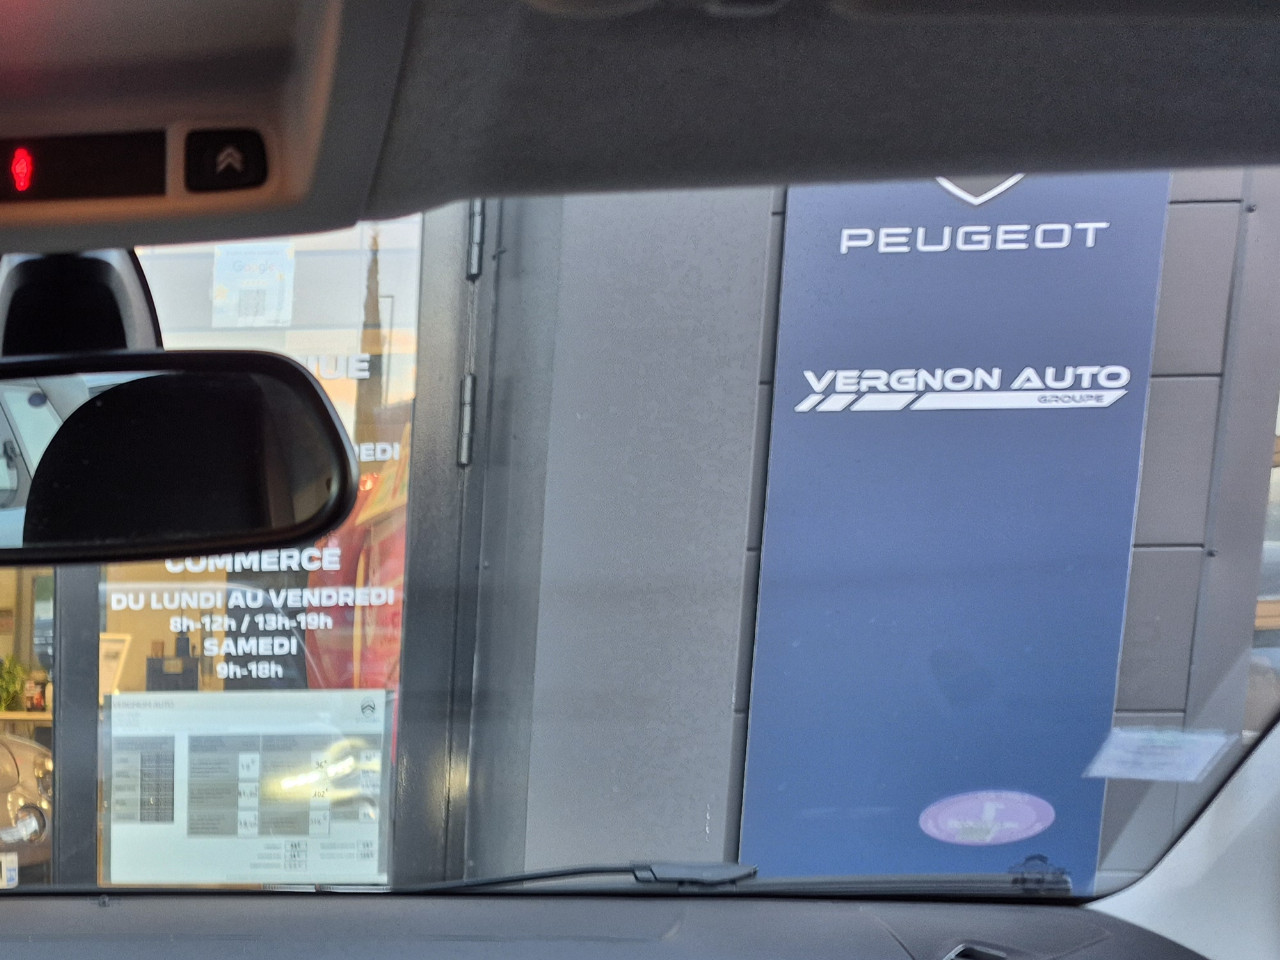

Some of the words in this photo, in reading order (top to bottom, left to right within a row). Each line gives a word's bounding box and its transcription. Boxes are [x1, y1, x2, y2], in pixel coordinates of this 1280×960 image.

[839, 221, 1110, 254] PEUGEOT
[803, 367, 1002, 393] VERGNON
[1010, 365, 1131, 390] AUTO
[1036, 393, 1105, 405] GROUPE
[111, 592, 144, 611] DU
[150, 590, 222, 610] LUNDI
[228, 589, 263, 609] AU
[269, 586, 395, 608] VENDREDI
[169, 613, 237, 633] 8h-12h
[240, 613, 250, 633] /
[203, 636, 297, 657] SAMEDI
[216, 661, 284, 679] 9h-18h
